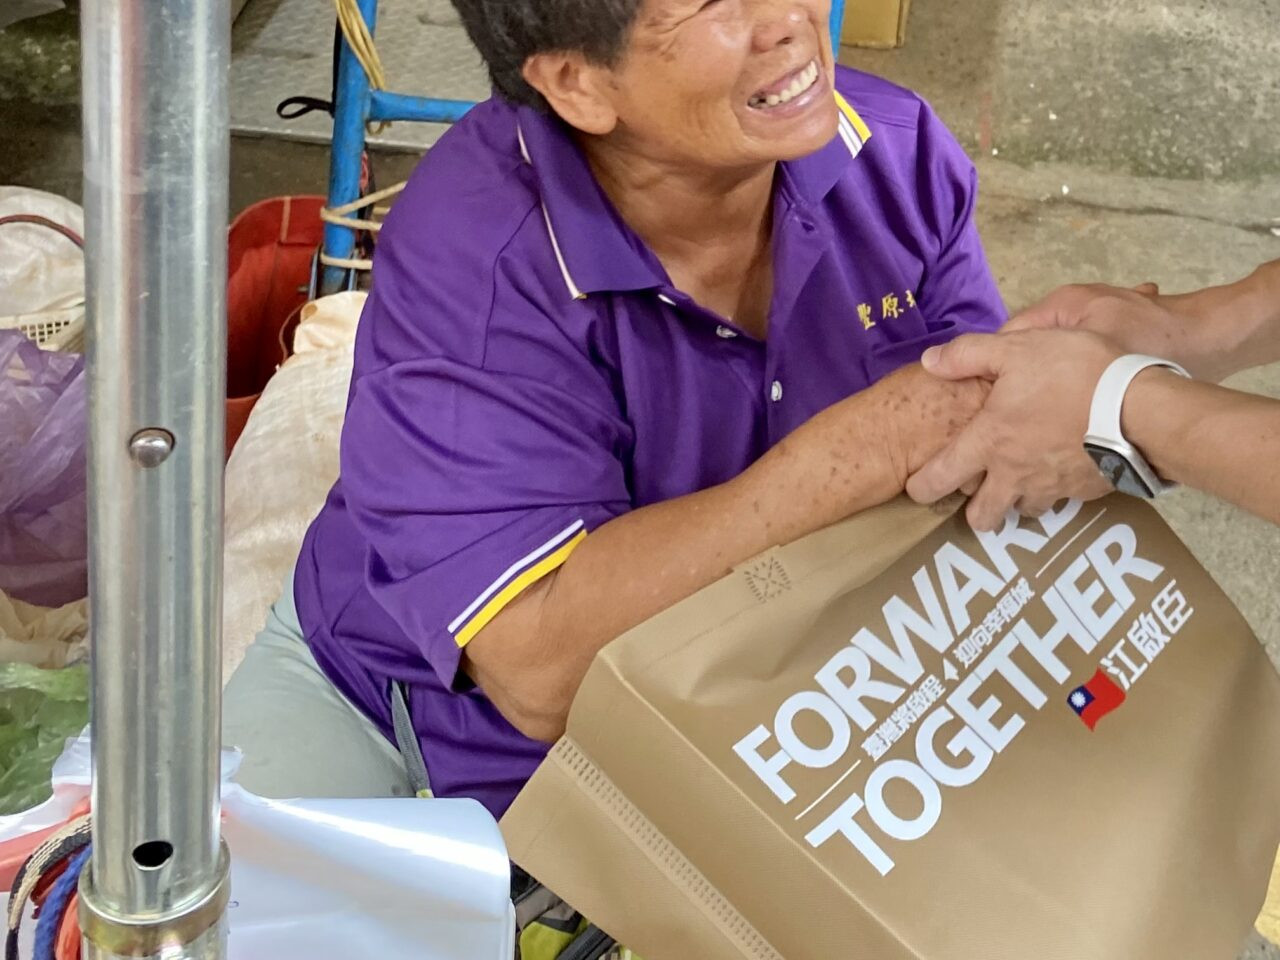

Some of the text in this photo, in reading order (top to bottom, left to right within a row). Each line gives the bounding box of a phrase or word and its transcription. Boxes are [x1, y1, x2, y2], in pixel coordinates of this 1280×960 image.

[804, 523, 1165, 877] TOGETHER
[1100, 579, 1194, 690] 江啟臣
